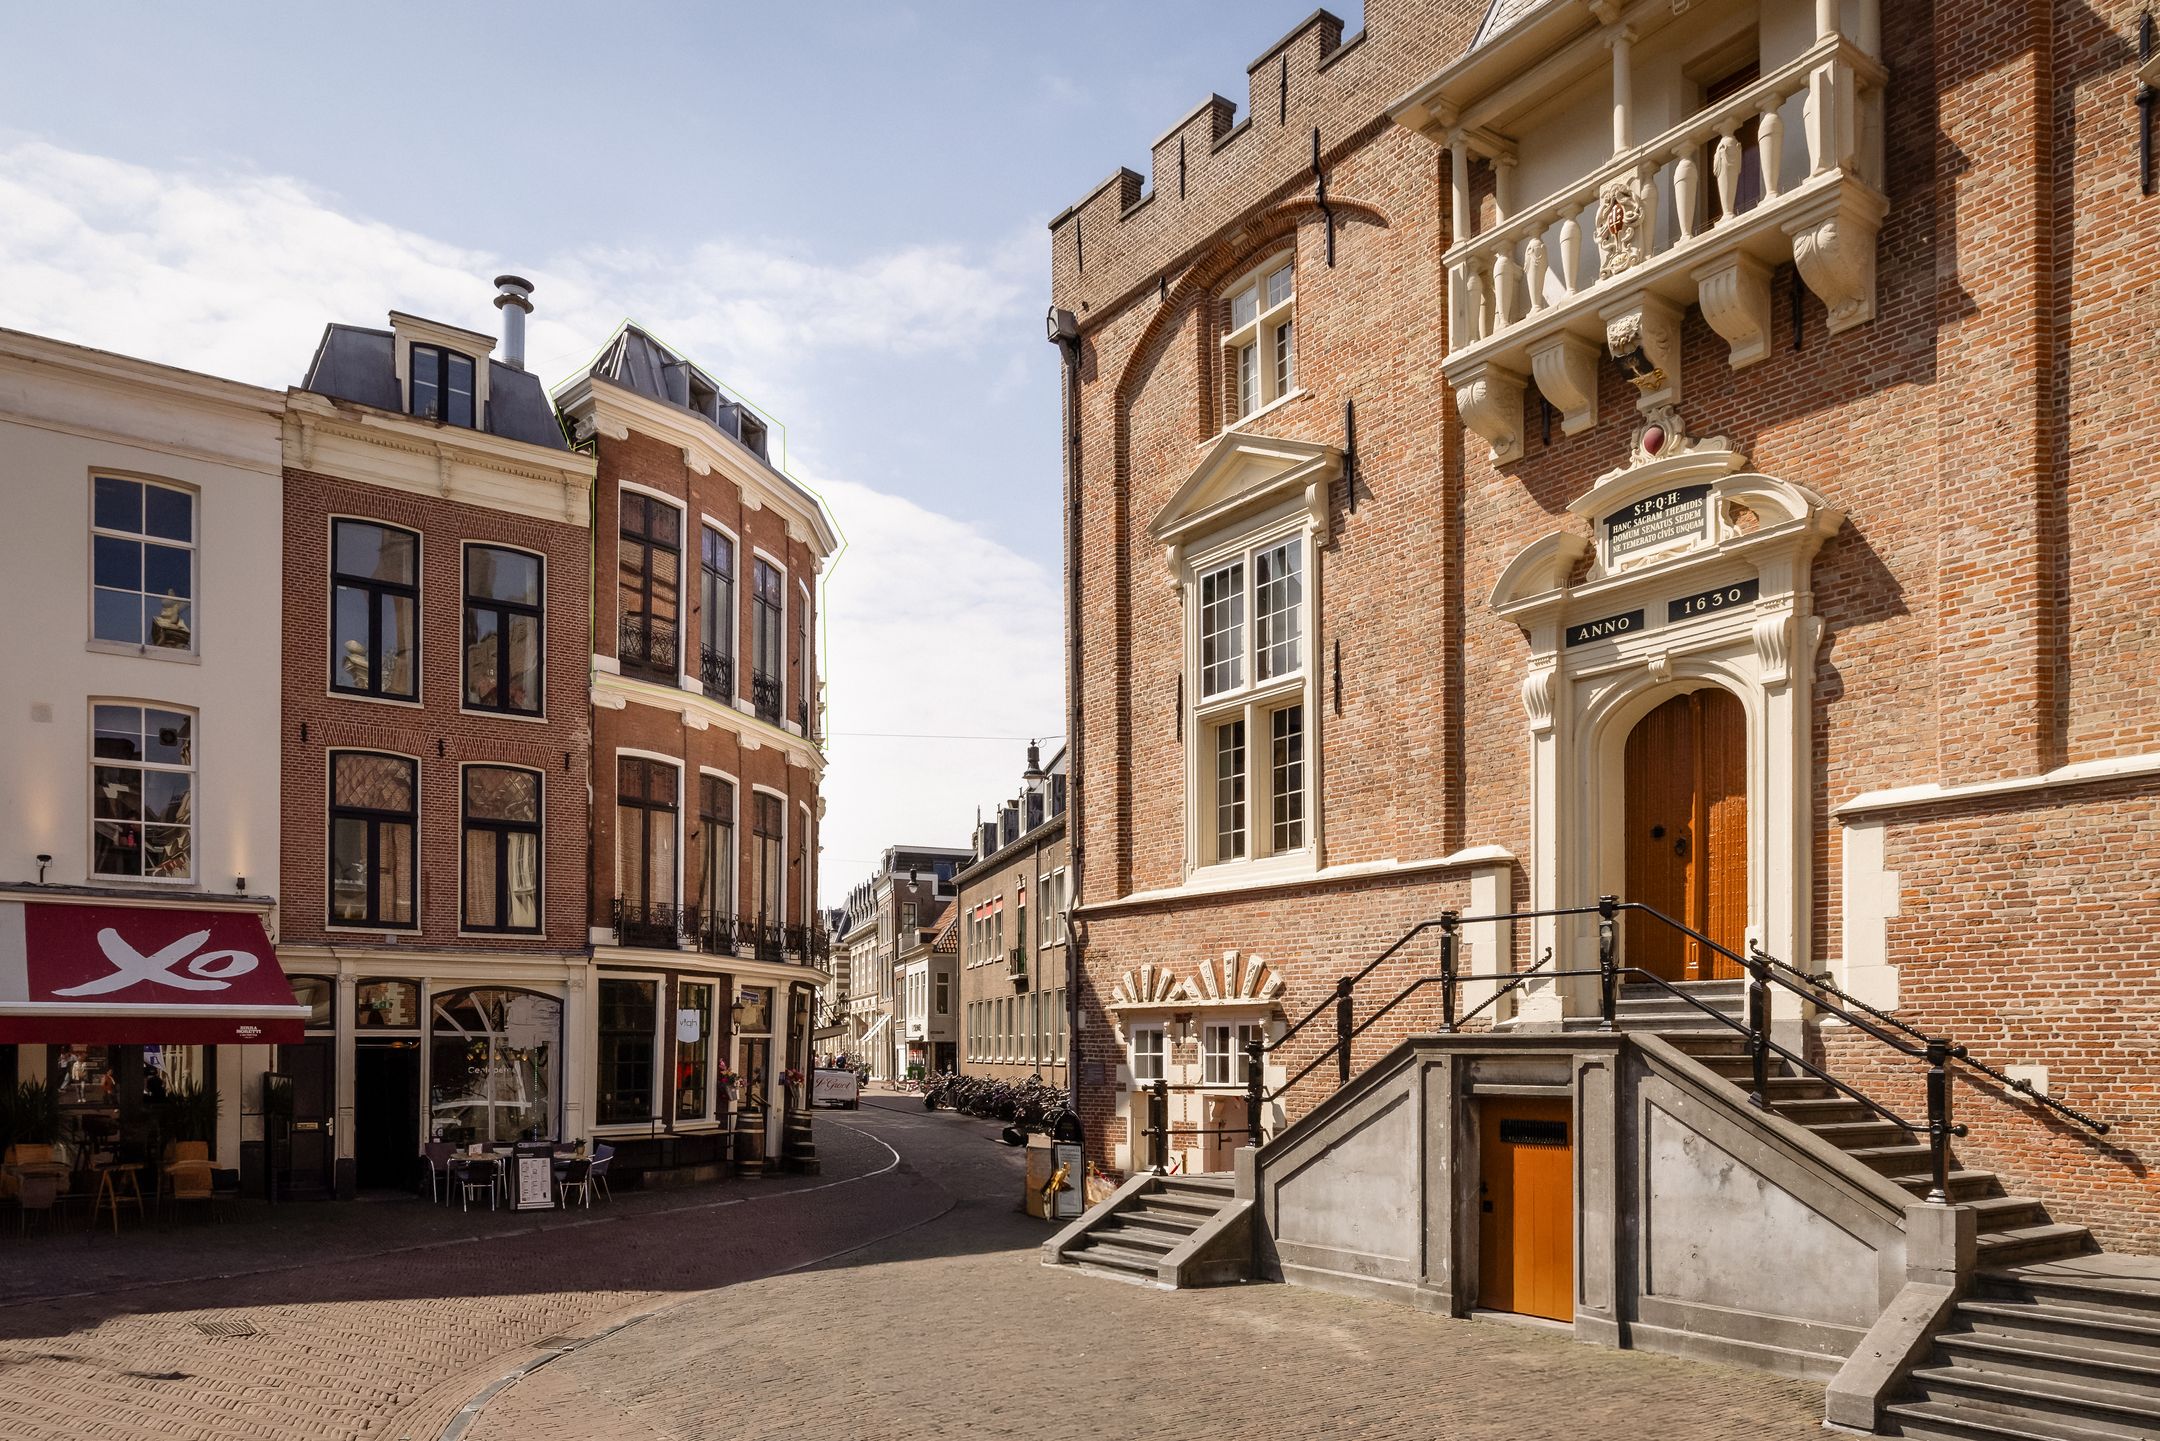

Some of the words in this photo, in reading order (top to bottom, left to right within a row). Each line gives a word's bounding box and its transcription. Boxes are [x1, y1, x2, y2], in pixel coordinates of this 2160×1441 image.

[1612, 521, 1632, 534] HANC
[1633, 511, 1663, 527] SACRAM
[1665, 498, 1703, 517] THEMIDIS
[1612, 529, 1640, 544] DOMUM
[1641, 518, 1673, 535] SENATUS
[1675, 509, 1701, 524] SEDEM
[1612, 544, 1622, 554] NE
[1622, 533, 1657, 550] TEMERATO
[1675, 518, 1705, 534] UNQUAM
[1578, 617, 1630, 641] ANNO
[1684, 589, 1741, 614] 1630
